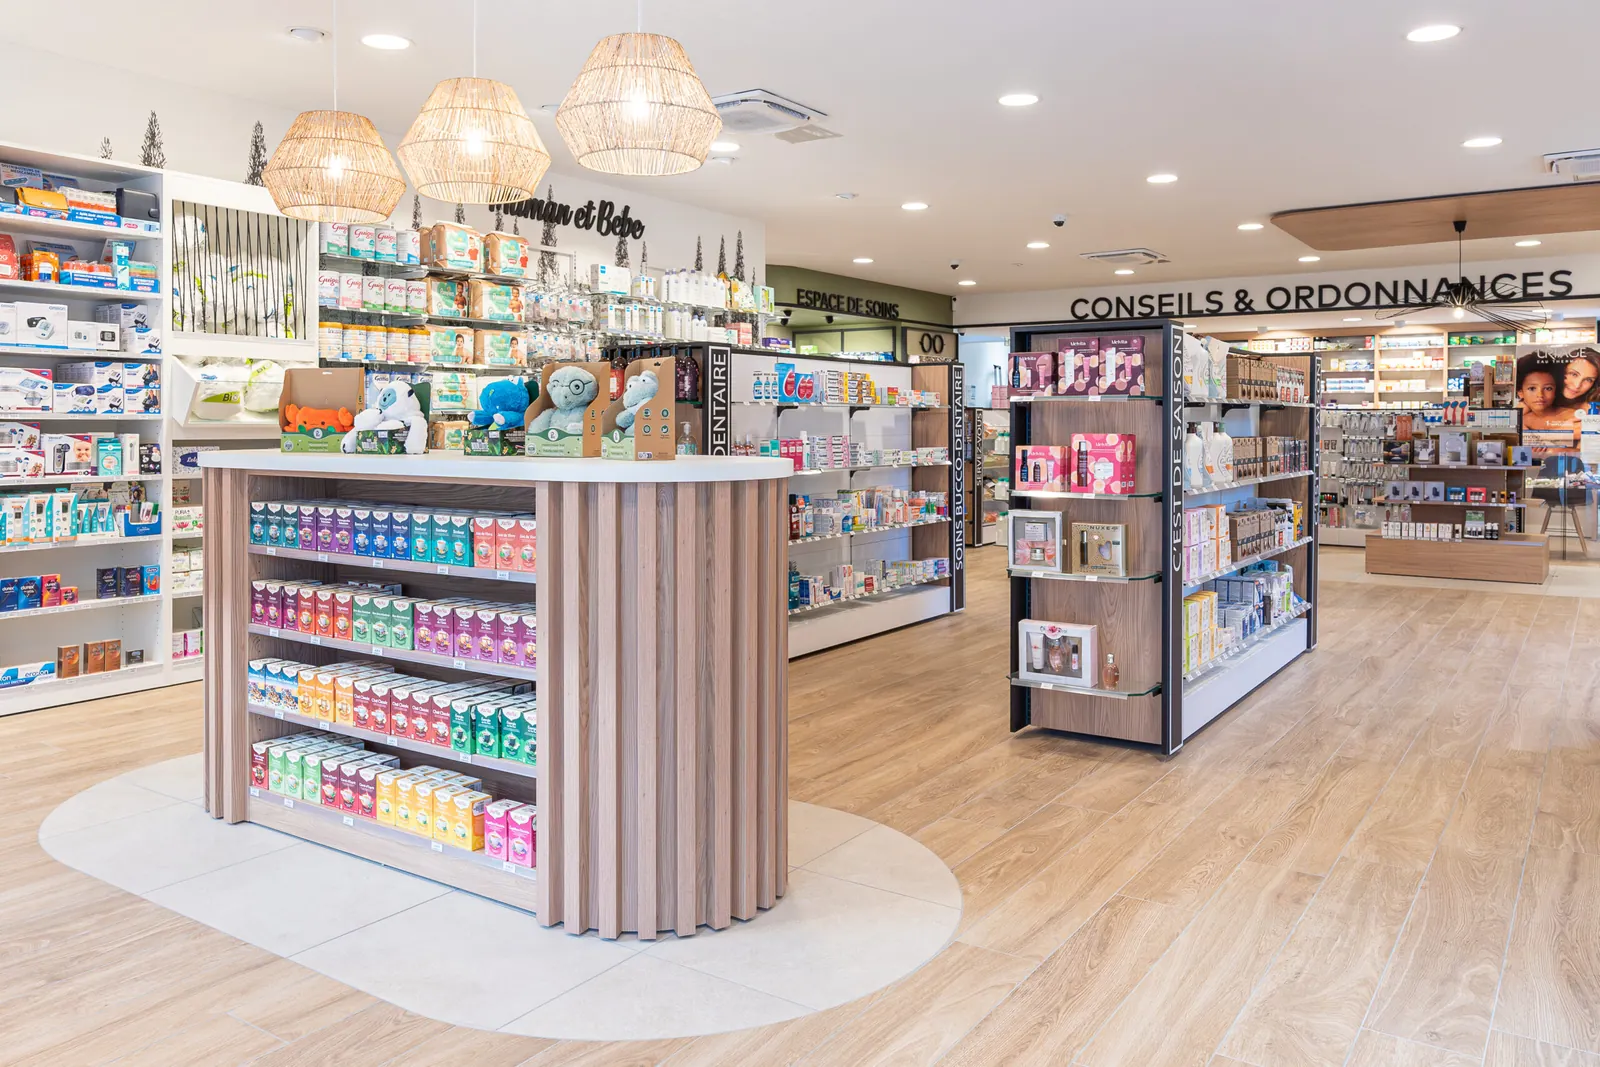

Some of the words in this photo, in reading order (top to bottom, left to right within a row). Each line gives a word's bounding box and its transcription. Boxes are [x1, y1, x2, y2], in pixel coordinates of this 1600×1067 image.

[574, 200, 596, 230] et
[597, 200, 645, 240] Bebe
[796, 288, 844, 312] ESPACE
[847, 296, 864, 314] DE
[866, 300, 900, 319] SOINS
[1070, 290, 1224, 320] CONSEILS
[1234, 288, 1256, 312] &
[1266, 270, 1573, 311] ORDONNANCES
[1537, 348, 1587, 360] URIAGE
[1173, 335, 1182, 440] SAISON
[954, 370, 964, 516] BUCCO-DENTAIRE
[1173, 448, 1182, 486] DE
[956, 520, 964, 570] SOINS
[1172, 494, 1182, 572] C'EST
